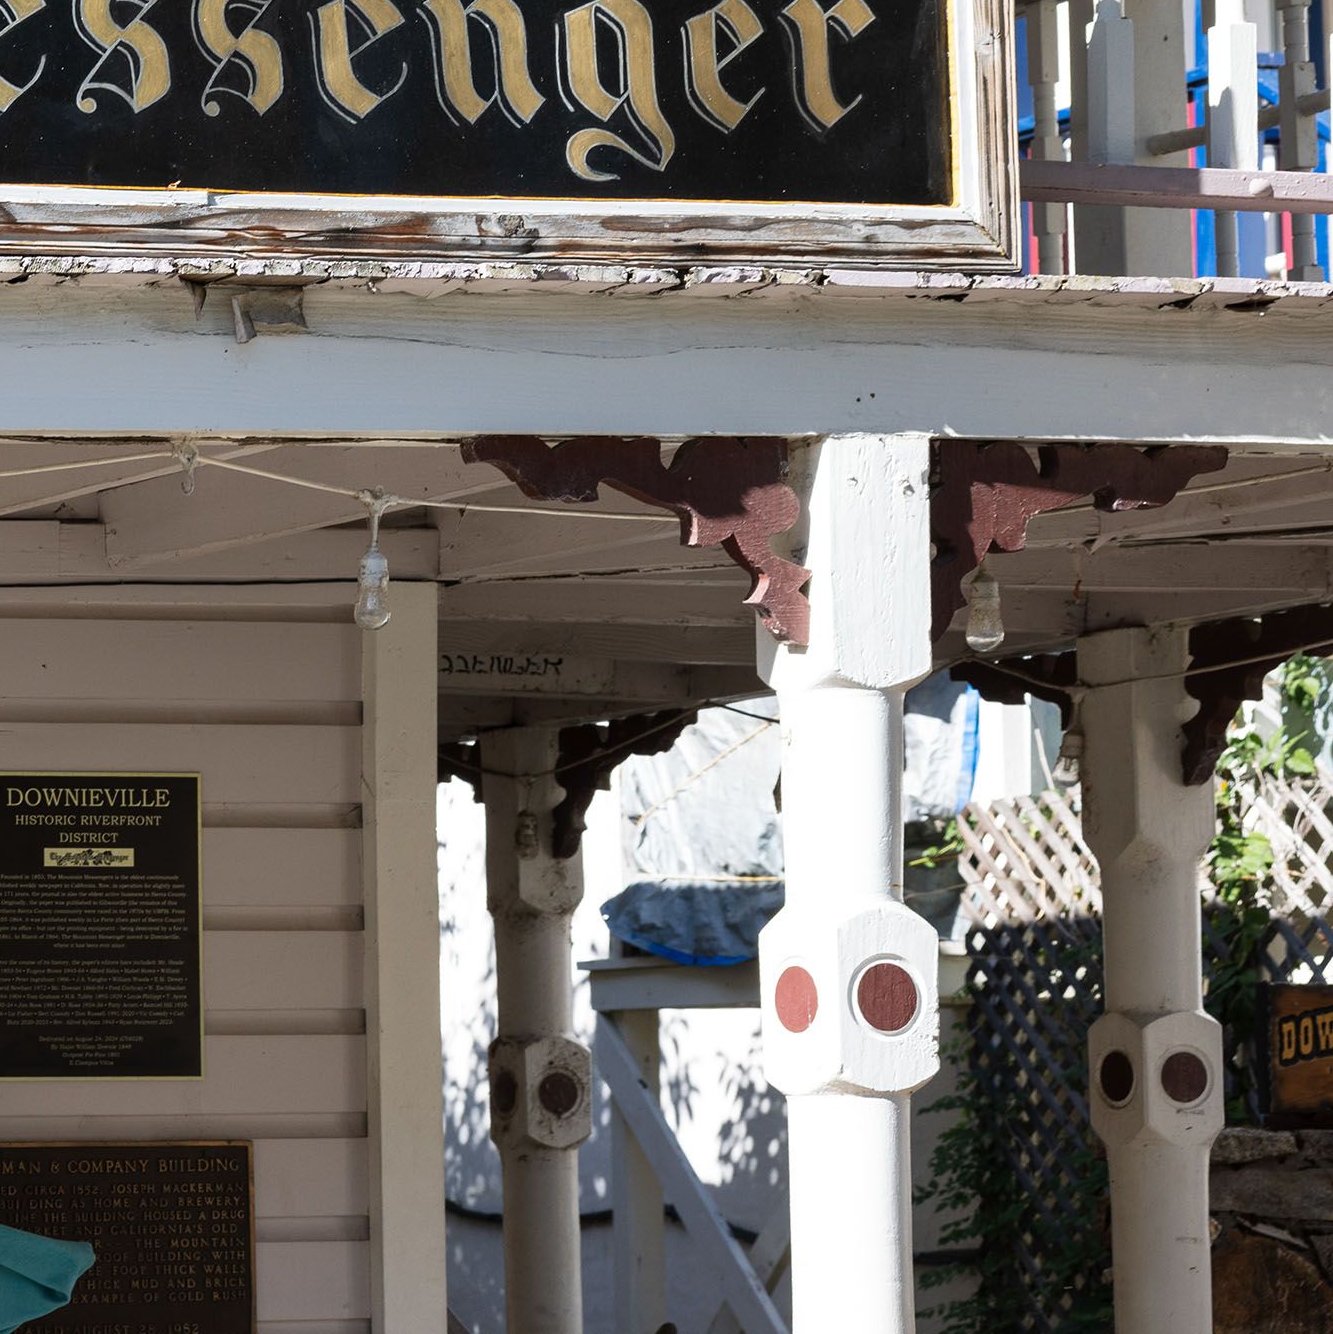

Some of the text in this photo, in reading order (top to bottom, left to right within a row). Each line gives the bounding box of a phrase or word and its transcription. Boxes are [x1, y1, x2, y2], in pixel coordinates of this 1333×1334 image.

[6, 787, 171, 808] DOWNIEVILLE
[15, 815, 162, 826] HISTORIC RIVERFRONT
[60, 832, 119, 843] DISTRICT
[51, 1161, 60, 1173] &
[68, 1160, 150, 1174] COMPANY
[159, 1158, 239, 1172] BUILDING
[25, 1185, 65, 1195] CIRCA
[111, 1184, 155, 1194] JOSEPH
[163, 1182, 244, 1194] MACKERMAN
[0, 1198, 62, 1210] BUIDING
[94, 1198, 130, 1208] HOME
[140, 1197, 168, 1208] AND
[43, 1212, 68, 1223] THE
[75, 1212, 134, 1222] BUILDING
[144, 1210, 192, 1221] HOUSED
[198, 1210, 207, 1220] A
[212, 1209, 245, 1220] DRUG
[75, 1226, 102, 1235] AND
[110, 1225, 203, 1235] CALIFORNIA'S
[212, 1224, 237, 1234] OLD
[135, 1237, 245, 1249] THE MOUNTAIN
[212, 1250, 245, 1260] WITH
[113, 1264, 245, 1275] FOOT THICK WALLS
[131, 1279, 159, 1289] MUD
[166, 1278, 196, 1288] AND
[205, 1277, 245, 1288] BRICK
[73, 1290, 246, 1304] EXAMPLE OF GOLD RUSH
